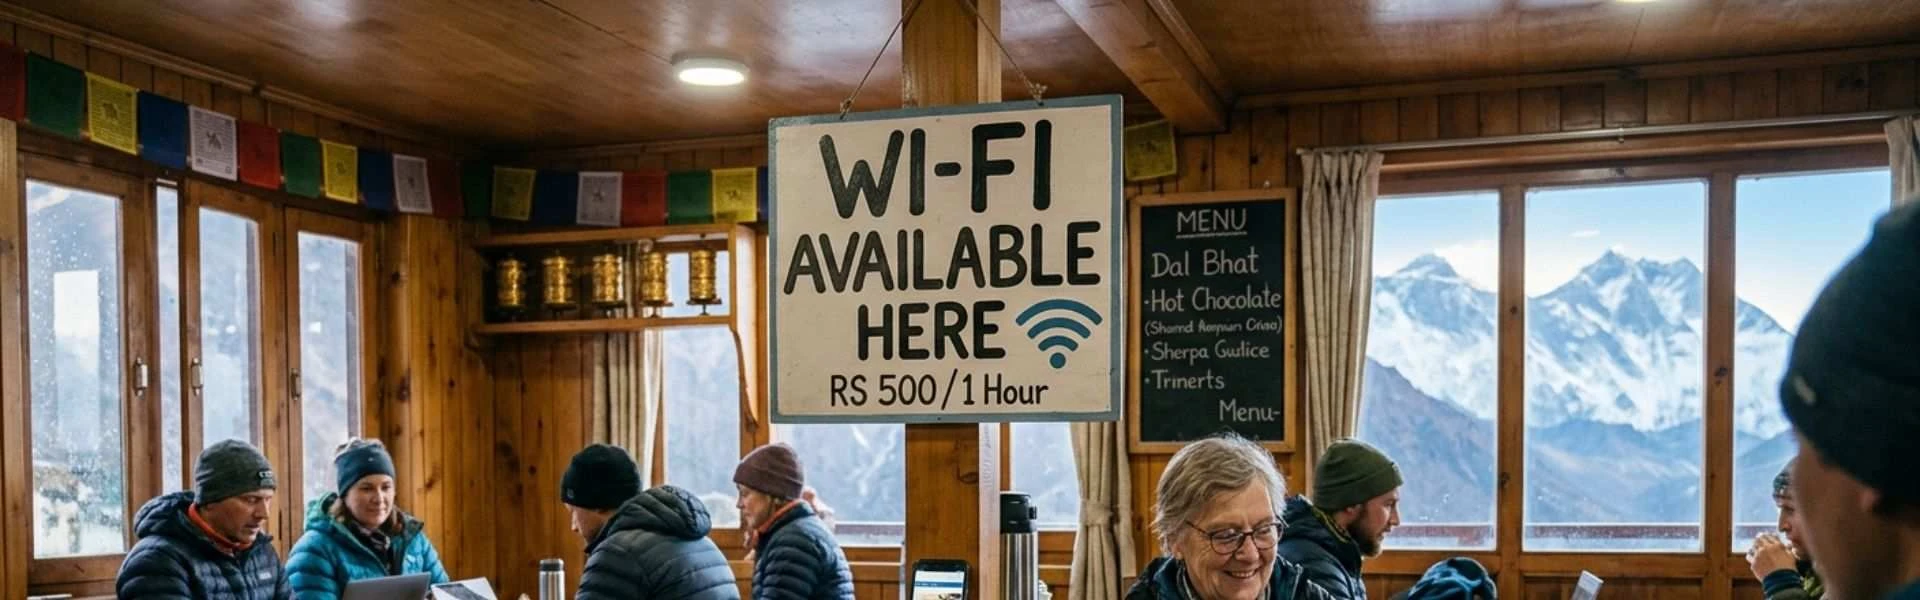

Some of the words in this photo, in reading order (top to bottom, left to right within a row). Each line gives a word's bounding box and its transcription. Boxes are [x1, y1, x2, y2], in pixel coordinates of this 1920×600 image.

[819, 119, 1052, 218] WI-FI
[1177, 208, 1247, 233] MENU
[783, 221, 1101, 295] AVAILABLE
[1151, 250, 1190, 278] Dal
[1203, 246, 1259, 276] Bhat
[1192, 282, 1282, 311] Chocolate
[857, 300, 1006, 361] HERE
[1151, 341, 1209, 366] Sherpa
[830, 373, 868, 407] RS
[984, 373, 1049, 406] Hour
